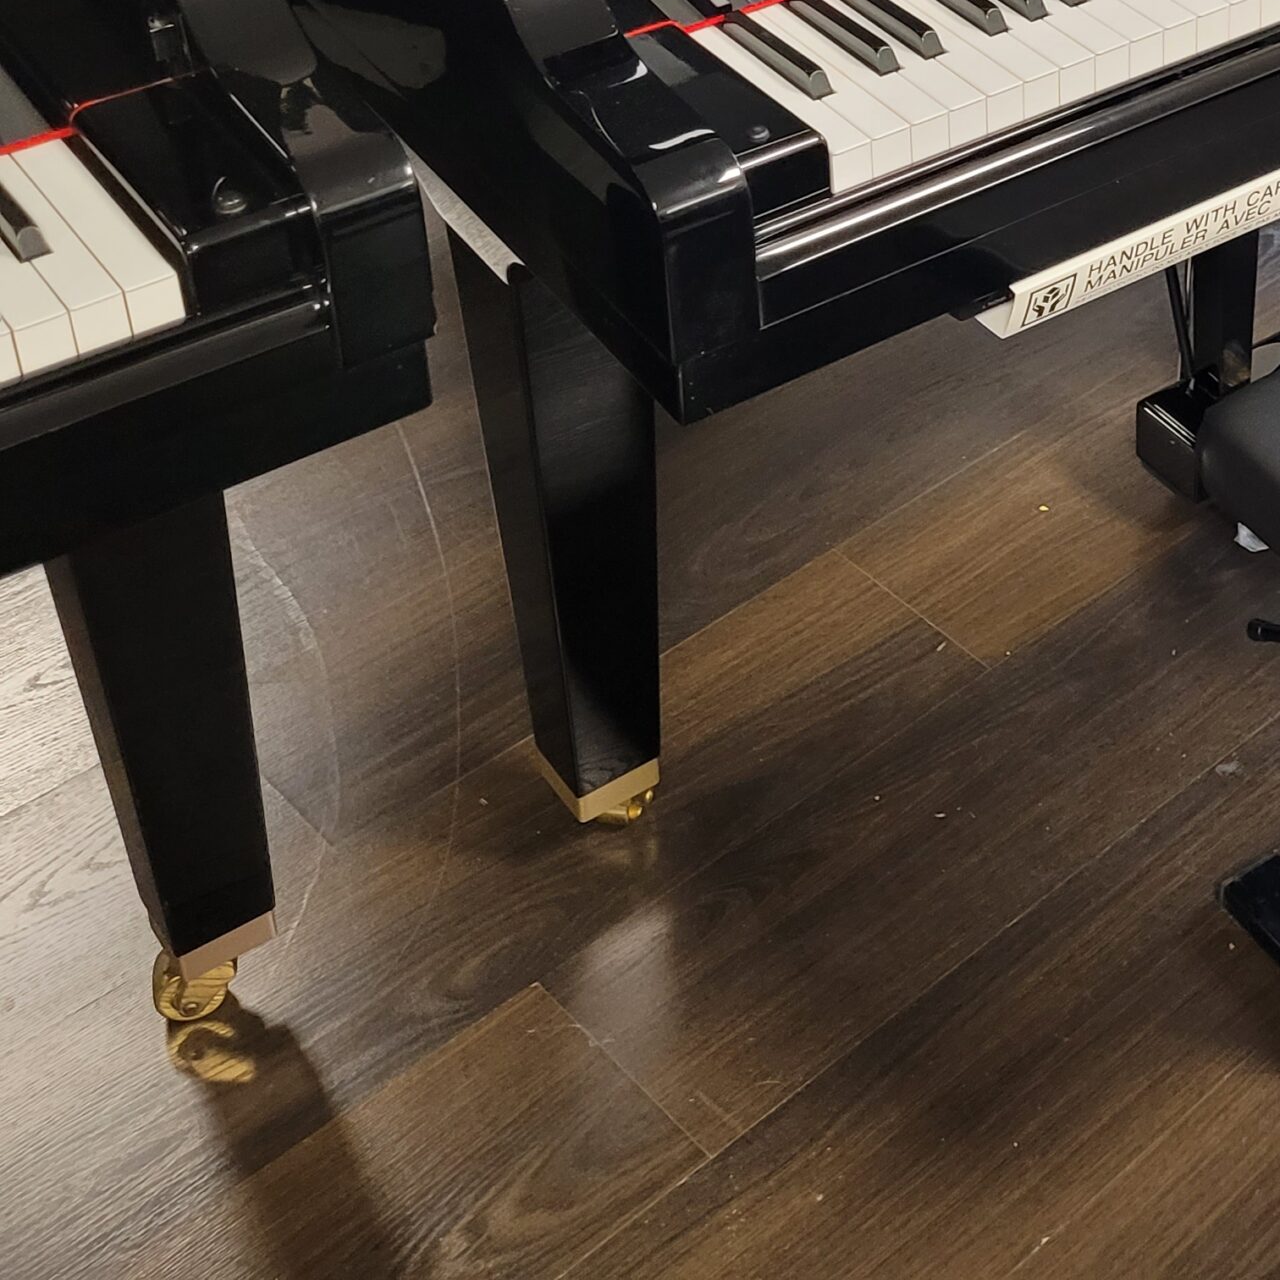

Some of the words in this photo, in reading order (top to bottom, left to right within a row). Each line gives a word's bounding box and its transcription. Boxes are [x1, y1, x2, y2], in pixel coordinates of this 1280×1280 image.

[1084, 228, 1208, 292] MANIPULER
[1216, 200, 1271, 234] AVEC
[1088, 228, 1174, 278] HANDLE
[1186, 200, 1237, 234] WITH
